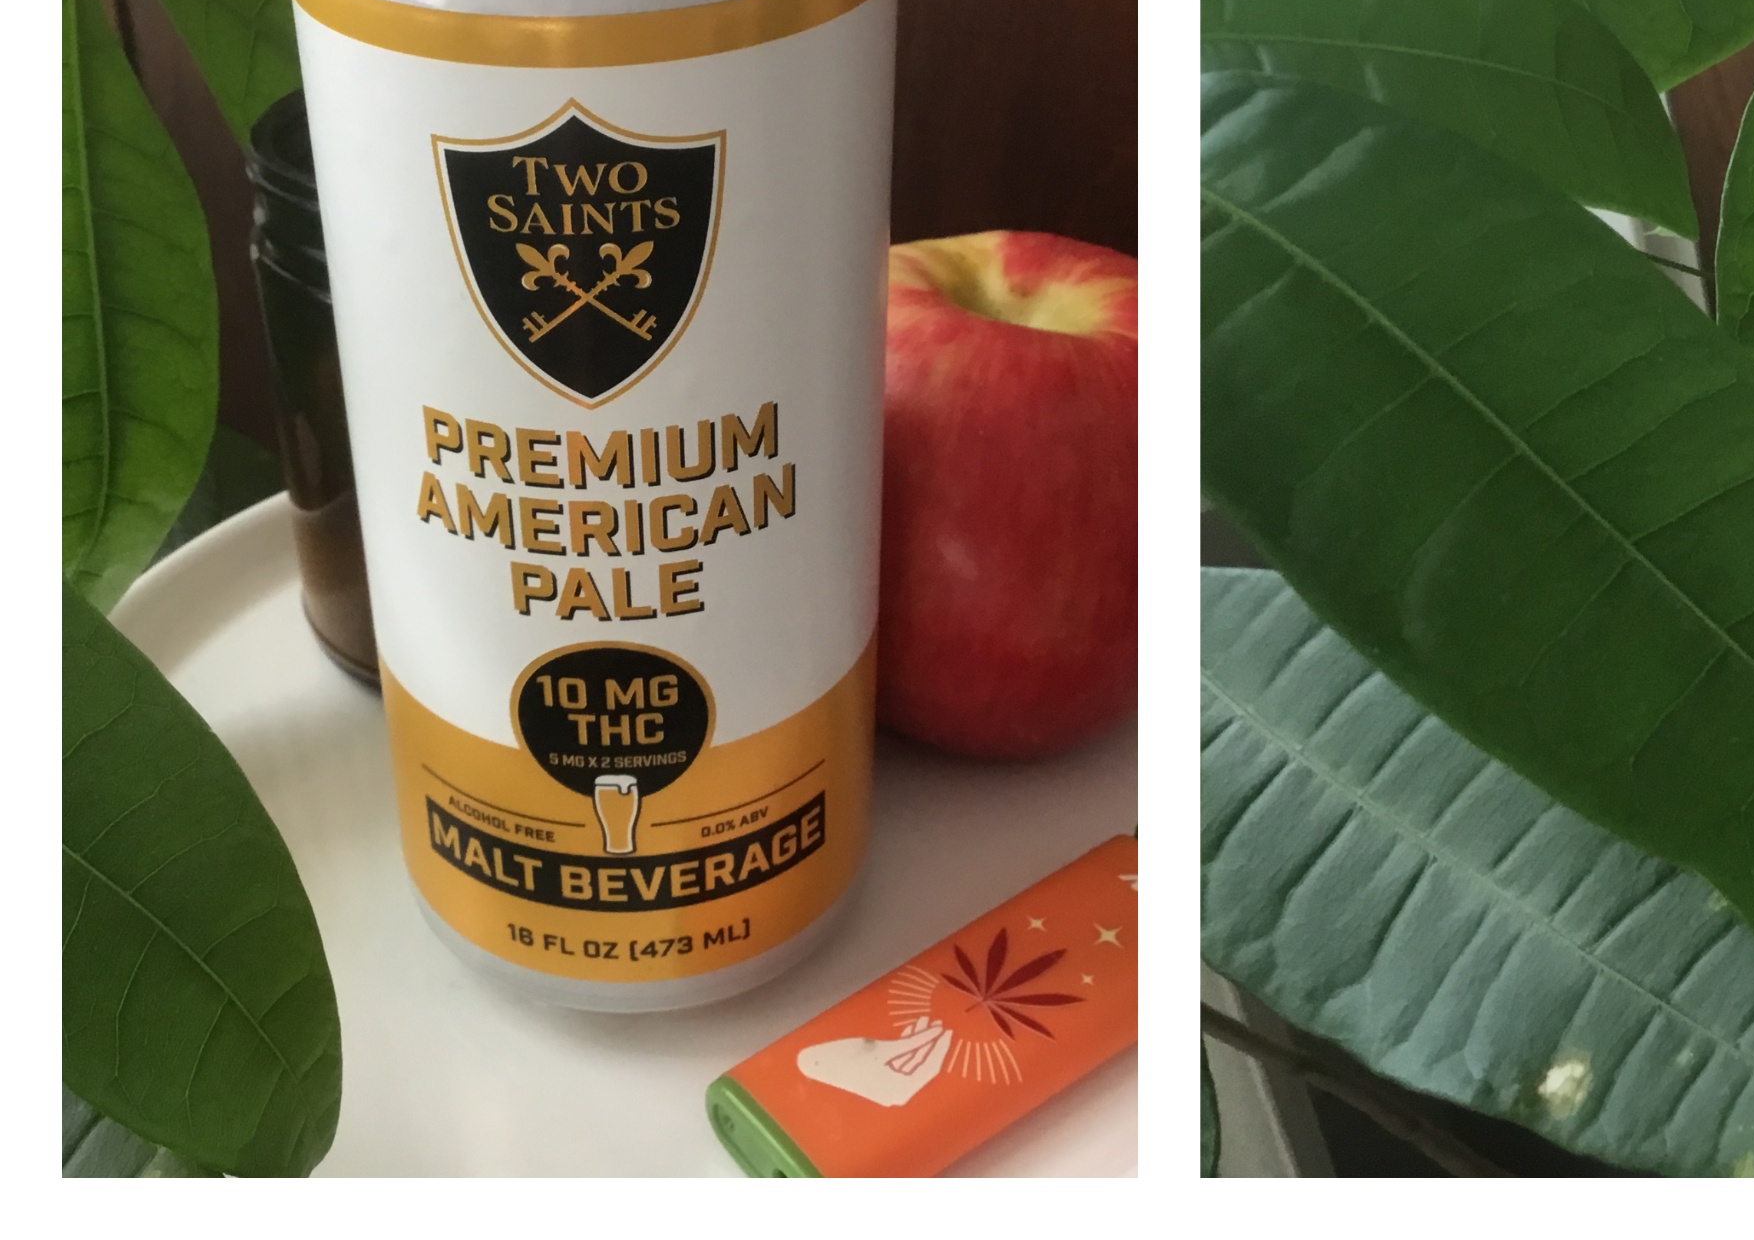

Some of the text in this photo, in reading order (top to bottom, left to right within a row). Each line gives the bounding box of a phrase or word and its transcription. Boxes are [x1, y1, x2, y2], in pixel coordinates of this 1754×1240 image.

[422, 401, 779, 489] PREMIUM
[417, 462, 797, 557] AMERICAN
[510, 558, 705, 621] PALE
[536, 674, 680, 711] 10 MG
[568, 712, 665, 747] THC
[548, 752, 559, 766] 5
[562, 754, 585, 768] MG
[601, 756, 612, 769] 2
[614, 750, 687, 769] SERVINGS
[448, 795, 556, 843] ALCOHOL FREE
[701, 806, 769, 838] 0.0% ABV
[430, 804, 822, 903] MALT BEVERAGE
[543, 933, 576, 956] FL
[583, 939, 619, 960] OZ
